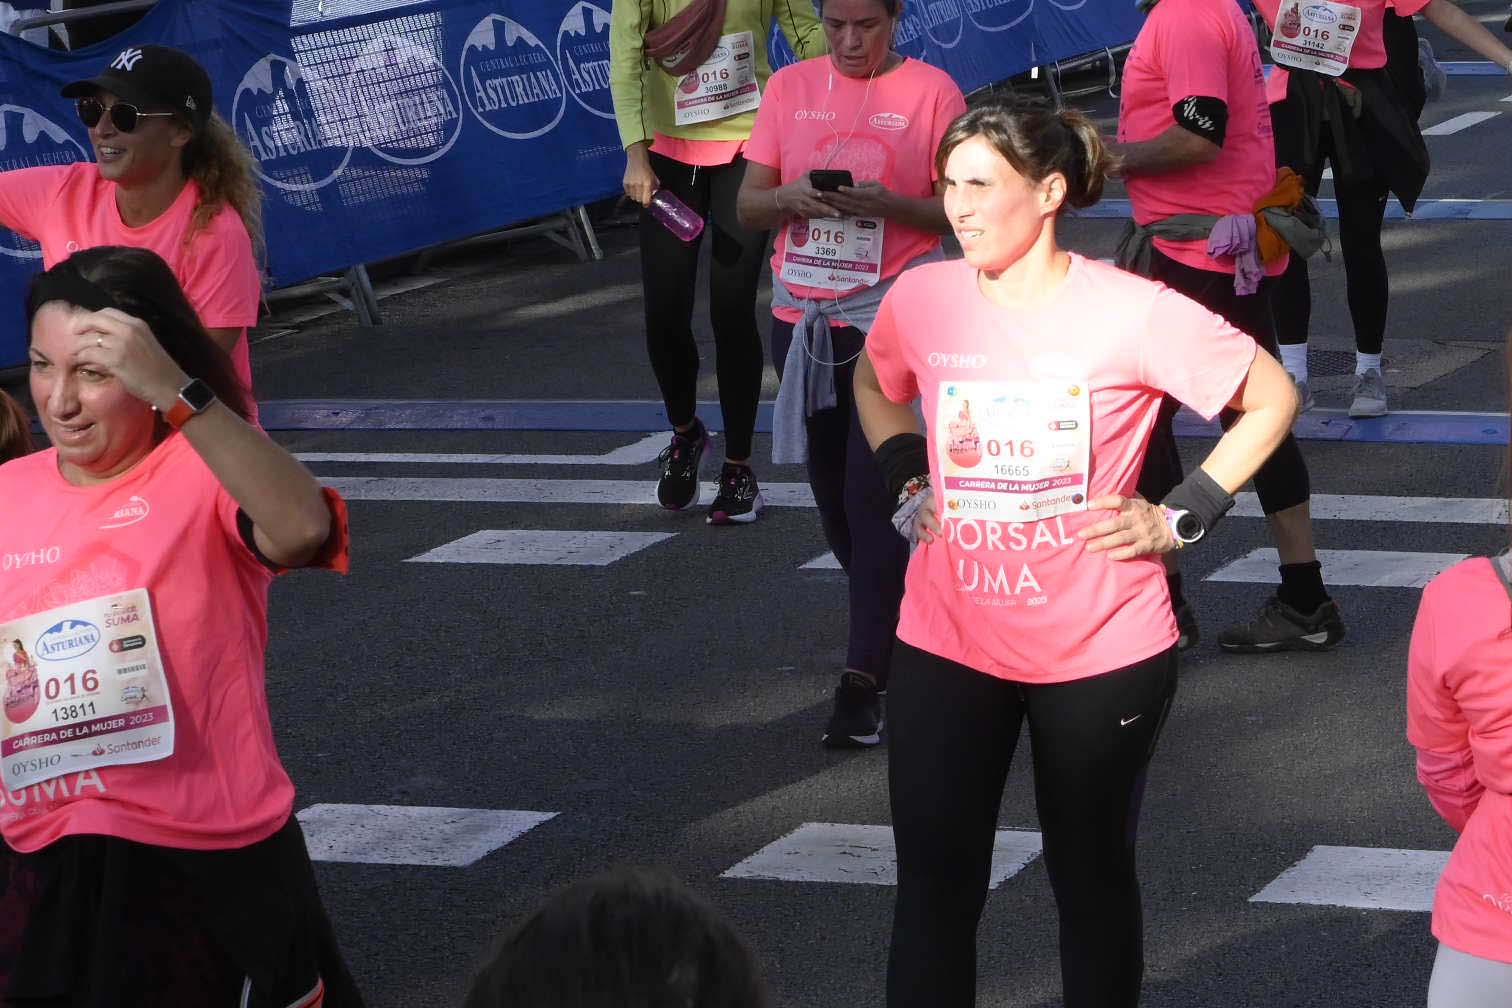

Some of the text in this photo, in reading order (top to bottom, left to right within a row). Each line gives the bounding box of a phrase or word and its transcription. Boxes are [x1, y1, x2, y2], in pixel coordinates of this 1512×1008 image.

[1303, 26, 1330, 41] 016
[1303, 39, 1325, 49] 31142
[702, 68, 729, 83] 016
[470, 66, 562, 113] ASTURIANA
[705, 82, 728, 94] 30988
[794, 109, 836, 121] OYSHO
[811, 227, 845, 244] 016
[815, 246, 837, 257] 3369
[928, 352, 988, 369] OYSHO
[987, 439, 1034, 458] 016
[994, 464, 1030, 477] 16665
[959, 480, 995, 490] CARRERA
[997, 481, 1007, 490] DE
[1009, 482, 1019, 491] LA
[1021, 481, 1049, 491] MUJER
[957, 495, 1072, 510] OYSHO Santande
[104, 612, 140, 628] SUMA
[42, 632, 96, 656] ASTURIANA
[44, 668, 100, 701] 016
[52, 701, 97, 722] 13811
[12, 712, 154, 749] CARRERA DE LA MUJER 2023
[11, 735, 161, 777] OYSHO Santander
